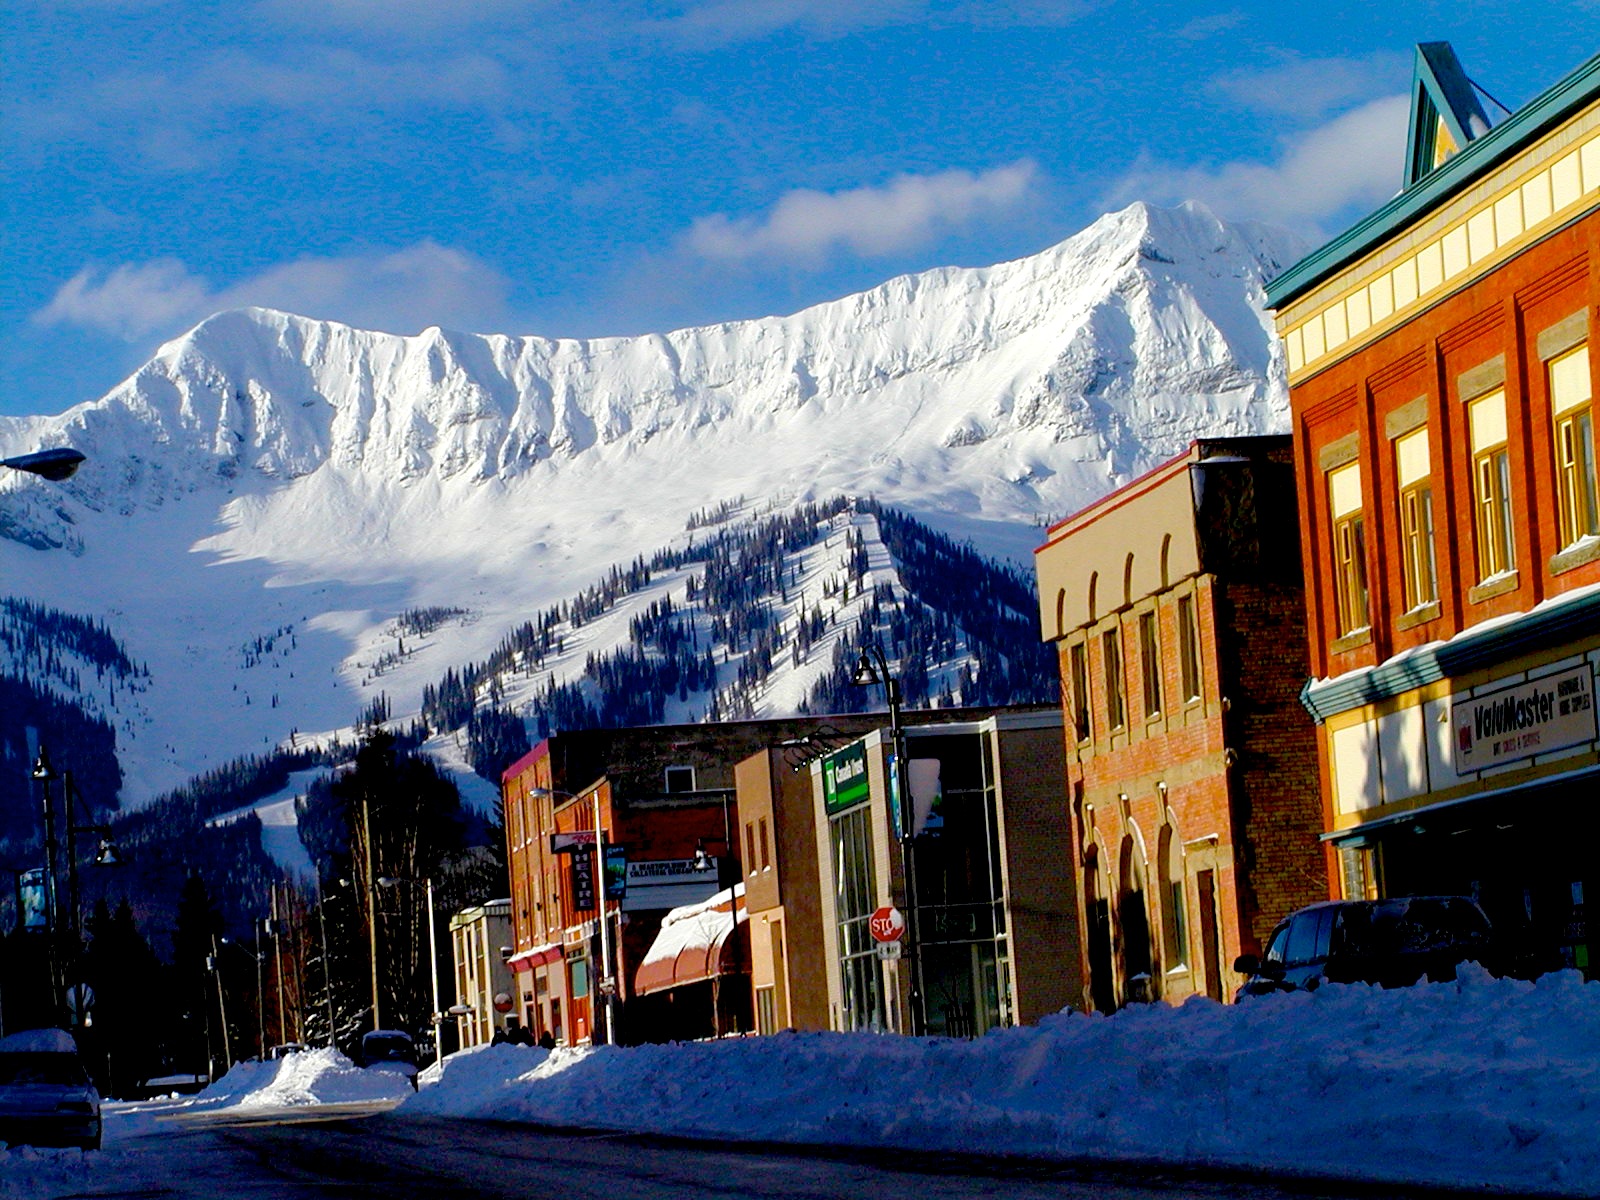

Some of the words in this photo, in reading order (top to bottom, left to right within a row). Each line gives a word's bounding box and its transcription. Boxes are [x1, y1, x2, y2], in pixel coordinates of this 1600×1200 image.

[1474, 688, 1555, 741] ValuMaster
[574, 843, 592, 908] THEATRE
[872, 918, 895, 932] STO
